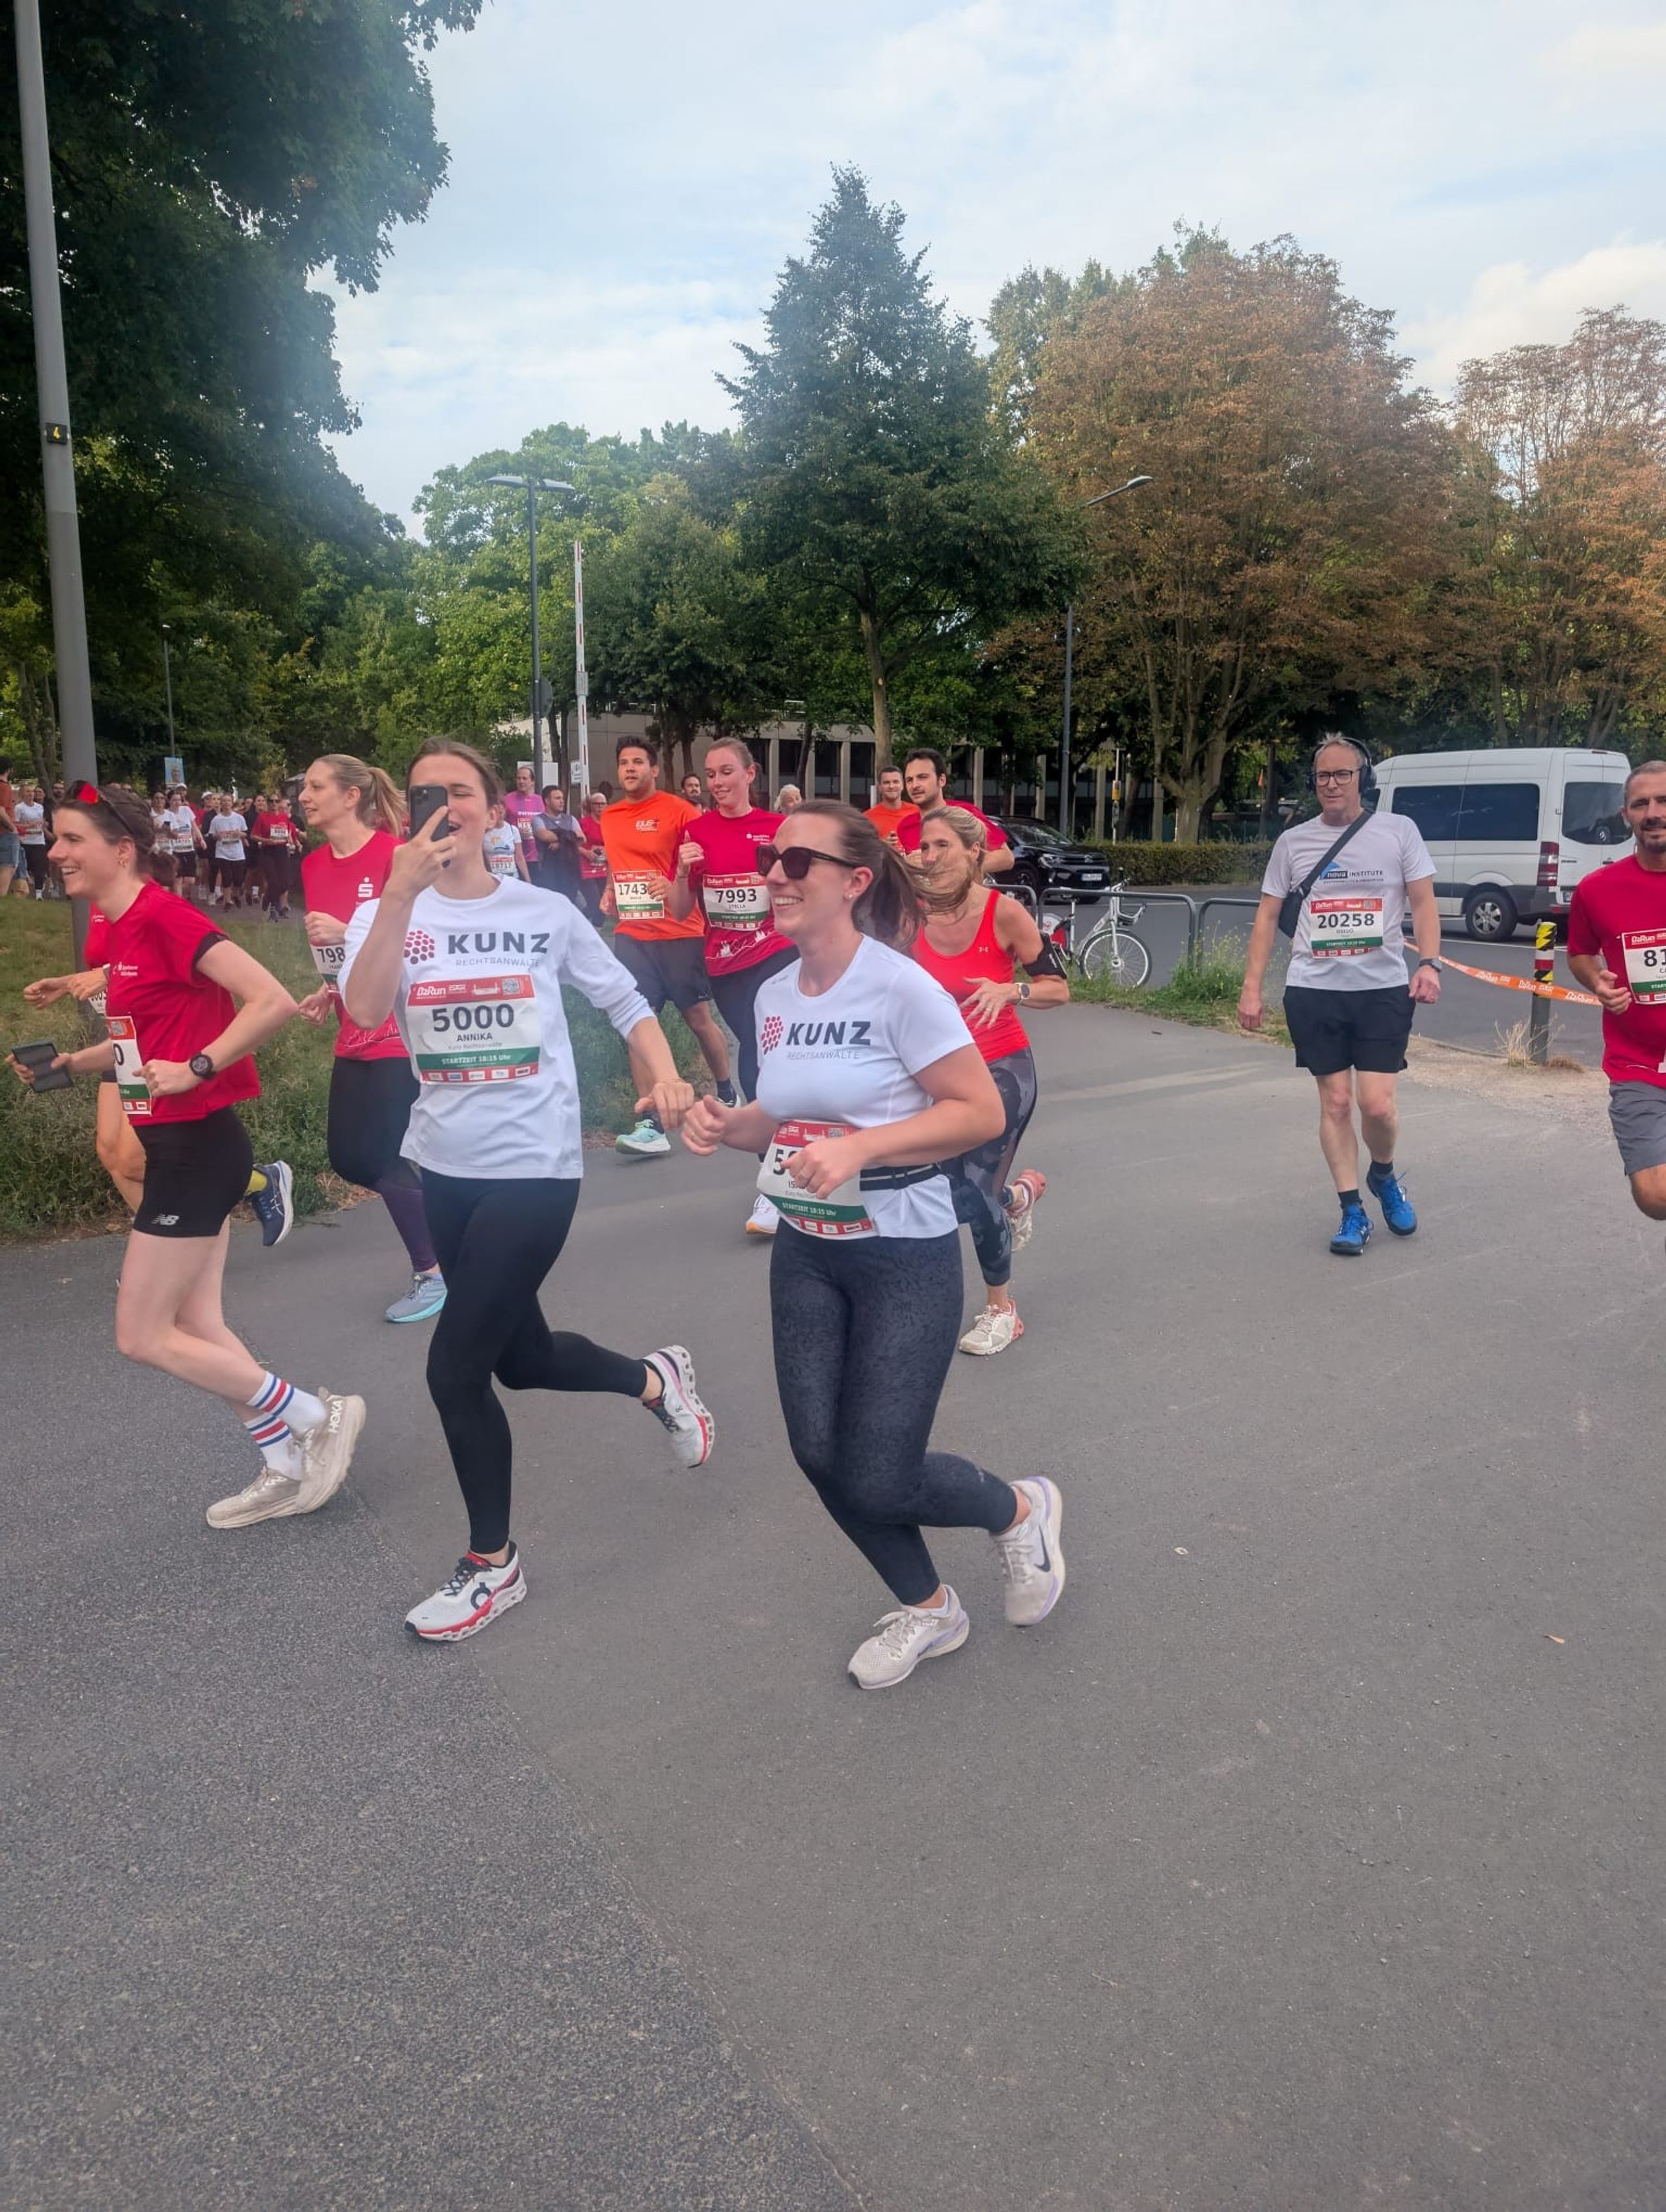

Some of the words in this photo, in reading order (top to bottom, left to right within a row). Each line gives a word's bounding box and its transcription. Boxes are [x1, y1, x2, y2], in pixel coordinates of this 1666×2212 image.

[618, 883, 650, 896] 1743
[715, 888, 757, 903] 7993
[1317, 913, 1374, 929] 20258
[448, 932, 550, 954] KUNZ
[317, 947, 346, 963] 798
[431, 1003, 515, 1032] 5000
[457, 1032, 493, 1042] ANNIKA
[785, 1021, 871, 1046] KUNZ
[441, 1056, 476, 1064] STARTZEIT
